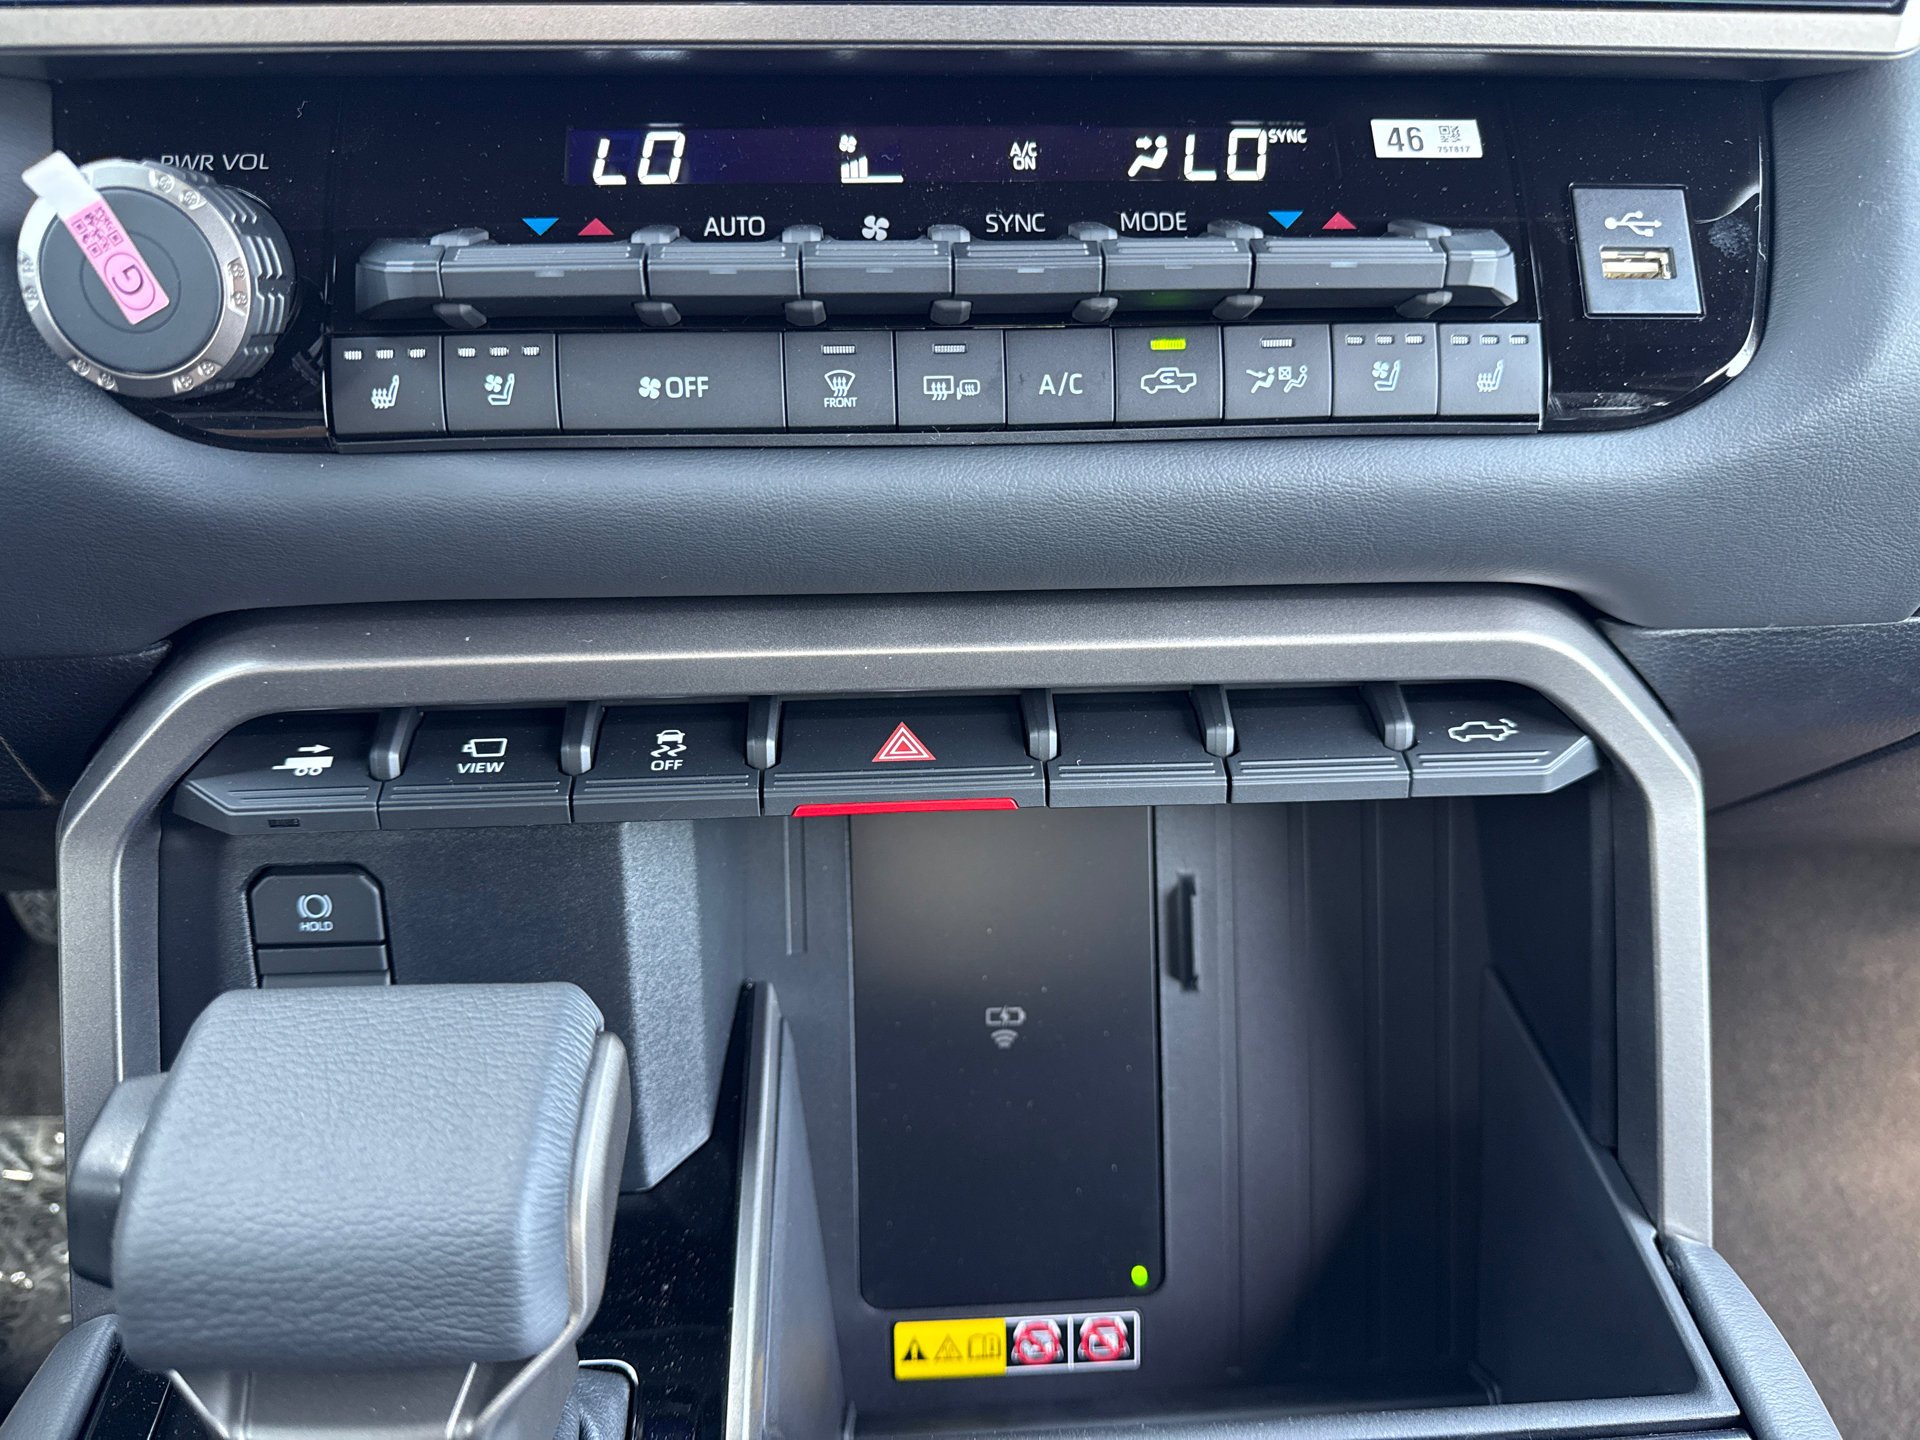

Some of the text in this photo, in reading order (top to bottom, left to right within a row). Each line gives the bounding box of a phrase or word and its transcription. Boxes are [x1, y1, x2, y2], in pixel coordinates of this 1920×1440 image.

[1267, 128, 1308, 144] SYNC
[1387, 126, 1425, 152] 46
[592, 130, 686, 186] LO
[1009, 141, 1038, 157] A/C
[1183, 128, 1267, 182] LO
[160, 153, 270, 171] PWR VOL
[1012, 155, 1037, 171] ON
[703, 216, 766, 237] AUTO
[985, 213, 1046, 233] SYNC
[1120, 211, 1188, 232] MODE
[665, 376, 709, 398] OFF
[1039, 371, 1084, 397] A/C
[823, 396, 858, 408] FRONT
[457, 761, 505, 774] VIEW
[650, 759, 683, 771] OFF
[299, 921, 334, 932] HOLD
